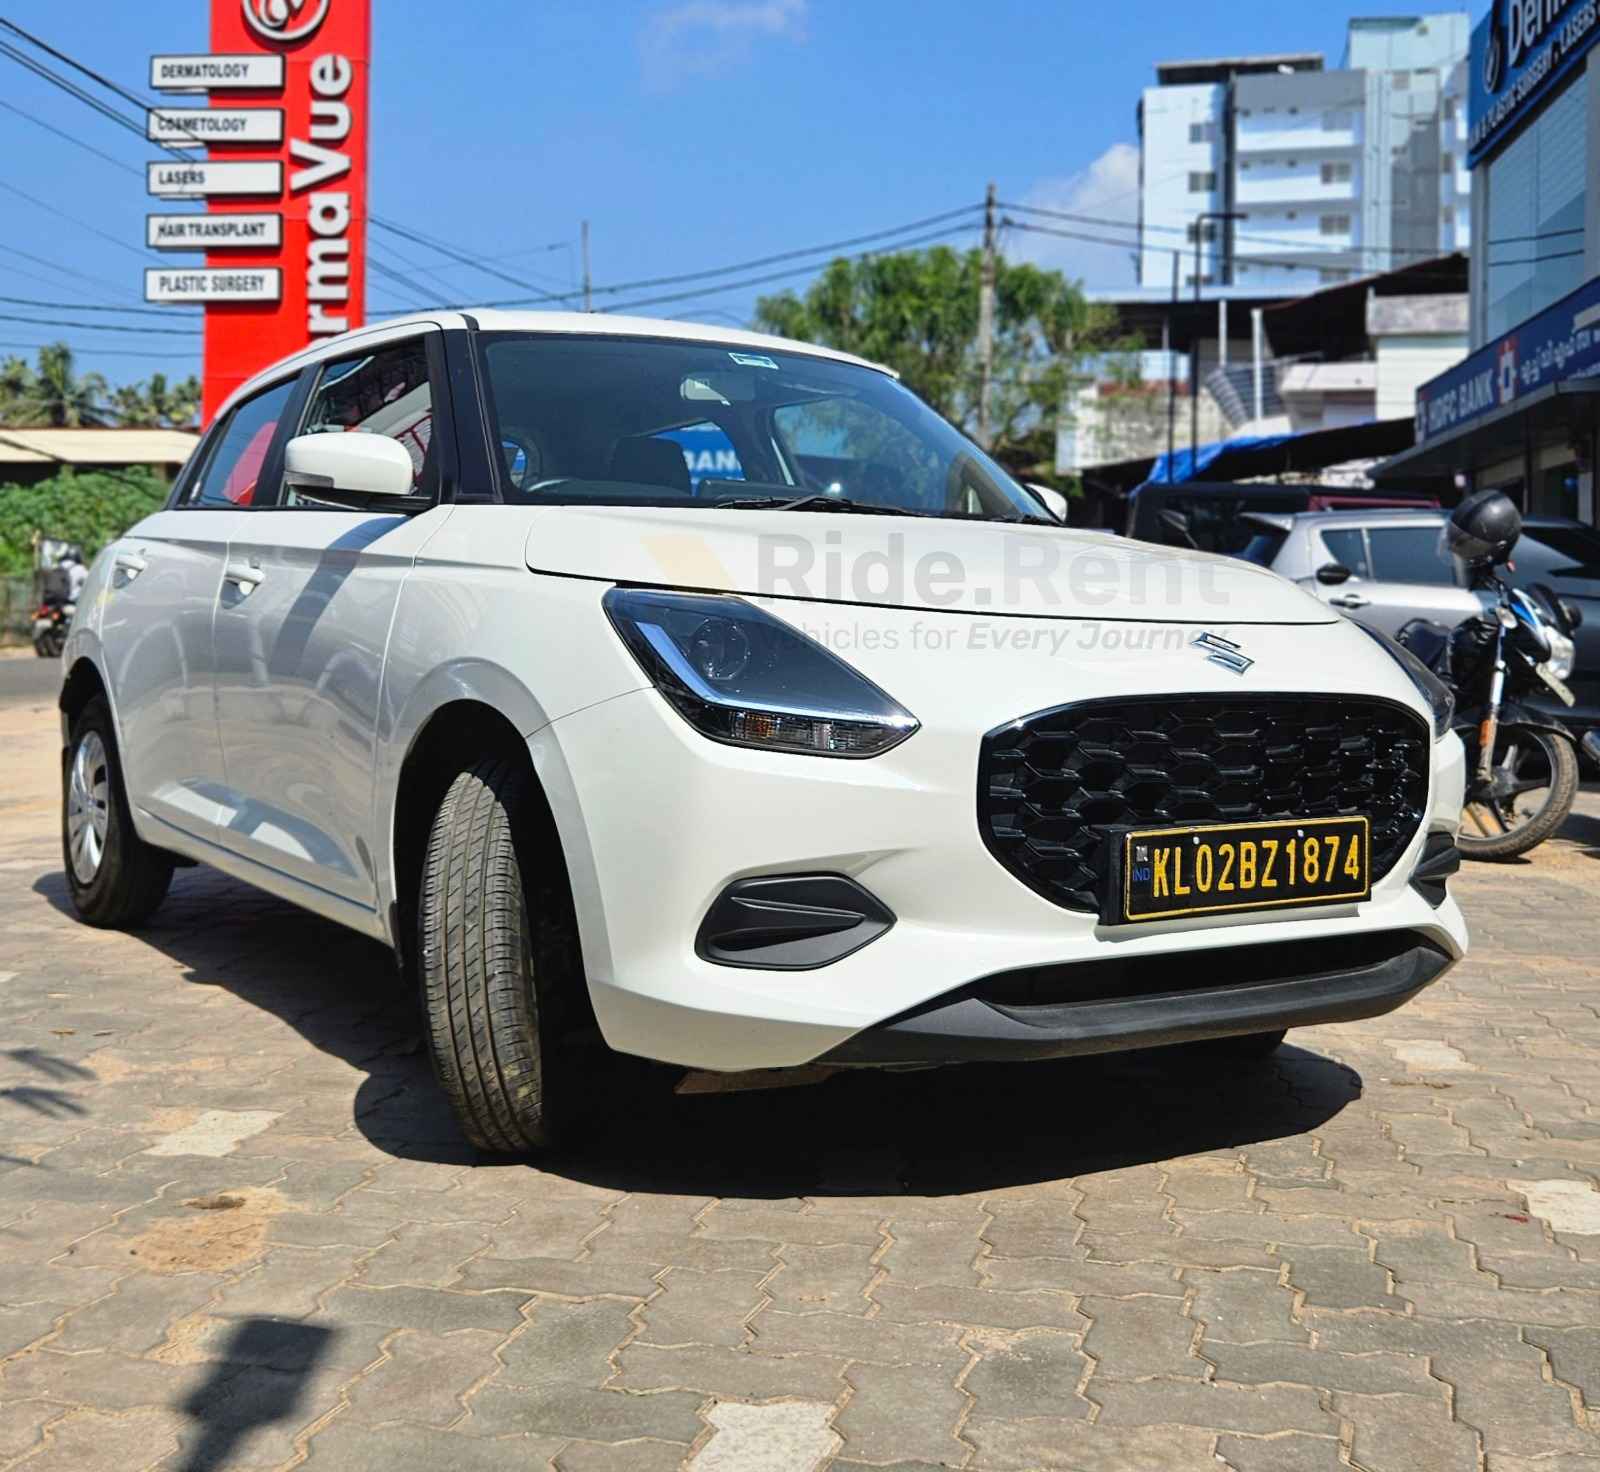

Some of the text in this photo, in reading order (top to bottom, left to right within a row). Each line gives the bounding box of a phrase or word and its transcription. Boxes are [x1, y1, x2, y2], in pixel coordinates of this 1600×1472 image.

[160, 63, 249, 79] DERMATOLOGY
[157, 117, 248, 132] COSMETOLOGY
[158, 170, 206, 185] LASERS
[288, 53, 352, 338] rmaVue
[157, 222, 266, 238] HAIR TRANSPLANT
[159, 275, 265, 293] PLASTIC SURGERY
[1459, 367, 1494, 419] BANK
[1152, 833, 1360, 898] KL02BZ1874
[1133, 867, 1150, 882] IND
